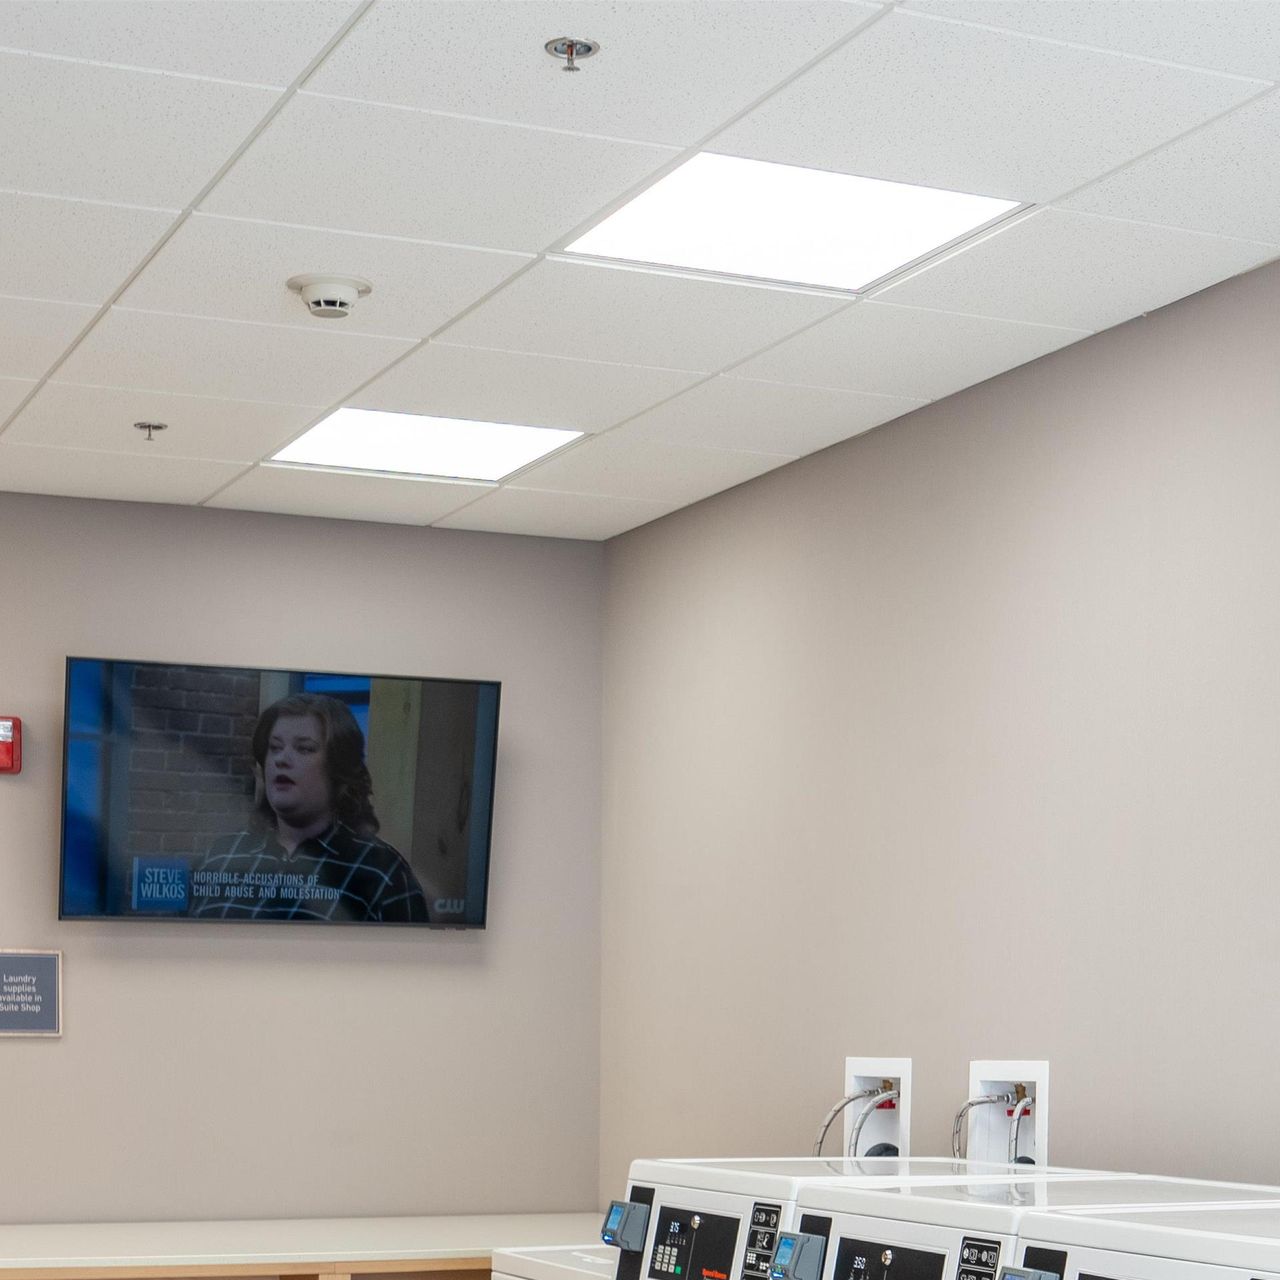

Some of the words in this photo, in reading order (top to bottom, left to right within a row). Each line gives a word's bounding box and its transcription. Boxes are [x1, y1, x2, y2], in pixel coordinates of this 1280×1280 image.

[145, 868, 182, 883] STEVE
[193, 871, 240, 884] HORRIBLE
[242, 873, 304, 886] ACCUSATIONS
[307, 874, 320, 887] OF
[141, 883, 185, 899] WILKOS
[193, 885, 221, 897] CHILD
[224, 886, 254, 898] ABUSE
[258, 887, 277, 899] AND
[280, 887, 341, 900] MOLESTATION
[3, 973, 36, 984] Laundry
[3, 983, 36, 994] supplies
[20, 1003, 40, 1013] Shop
